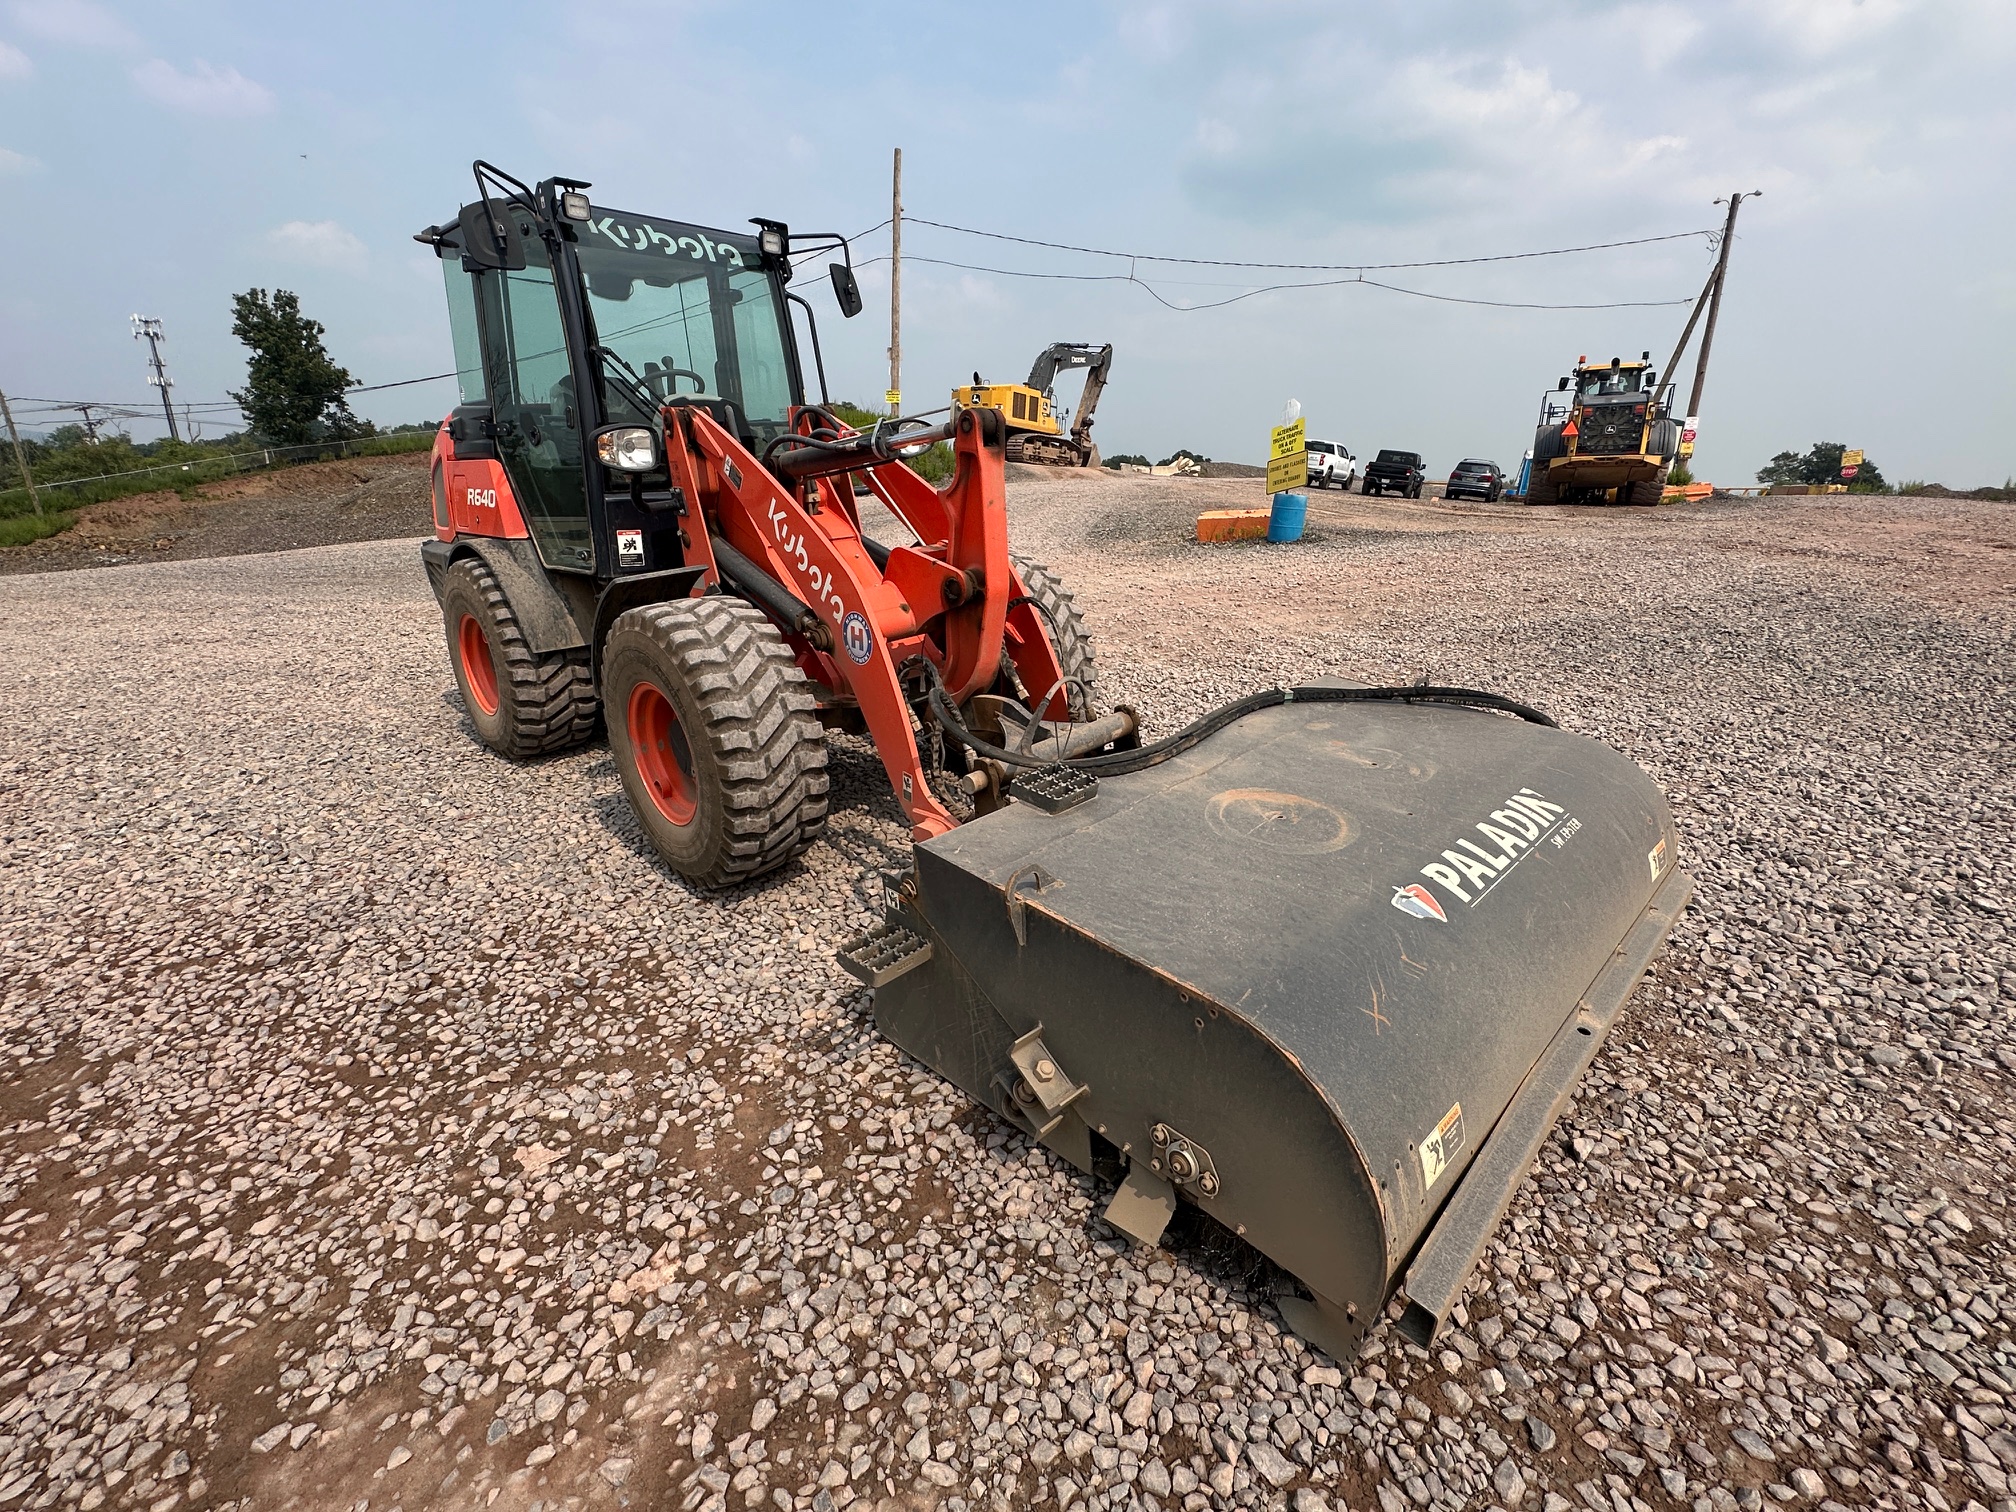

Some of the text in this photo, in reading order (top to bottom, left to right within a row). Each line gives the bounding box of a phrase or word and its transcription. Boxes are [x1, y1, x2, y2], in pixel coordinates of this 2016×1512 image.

[586, 217, 744, 266] Kubota
[1272, 429, 1303, 444] TRUCK TRAFFIC
[1277, 424, 1299, 436] ALTERNATE
[1280, 446, 1294, 454] SCALE
[1272, 477, 1287, 486] ENTERING
[467, 488, 496, 508] R640
[767, 497, 844, 624] Kubota
[845, 613, 869, 630] HIGHWAY
[850, 625, 864, 651] H
[845, 644, 870, 664] EQUIPMENT
[1420, 787, 1564, 903] PALADIN
